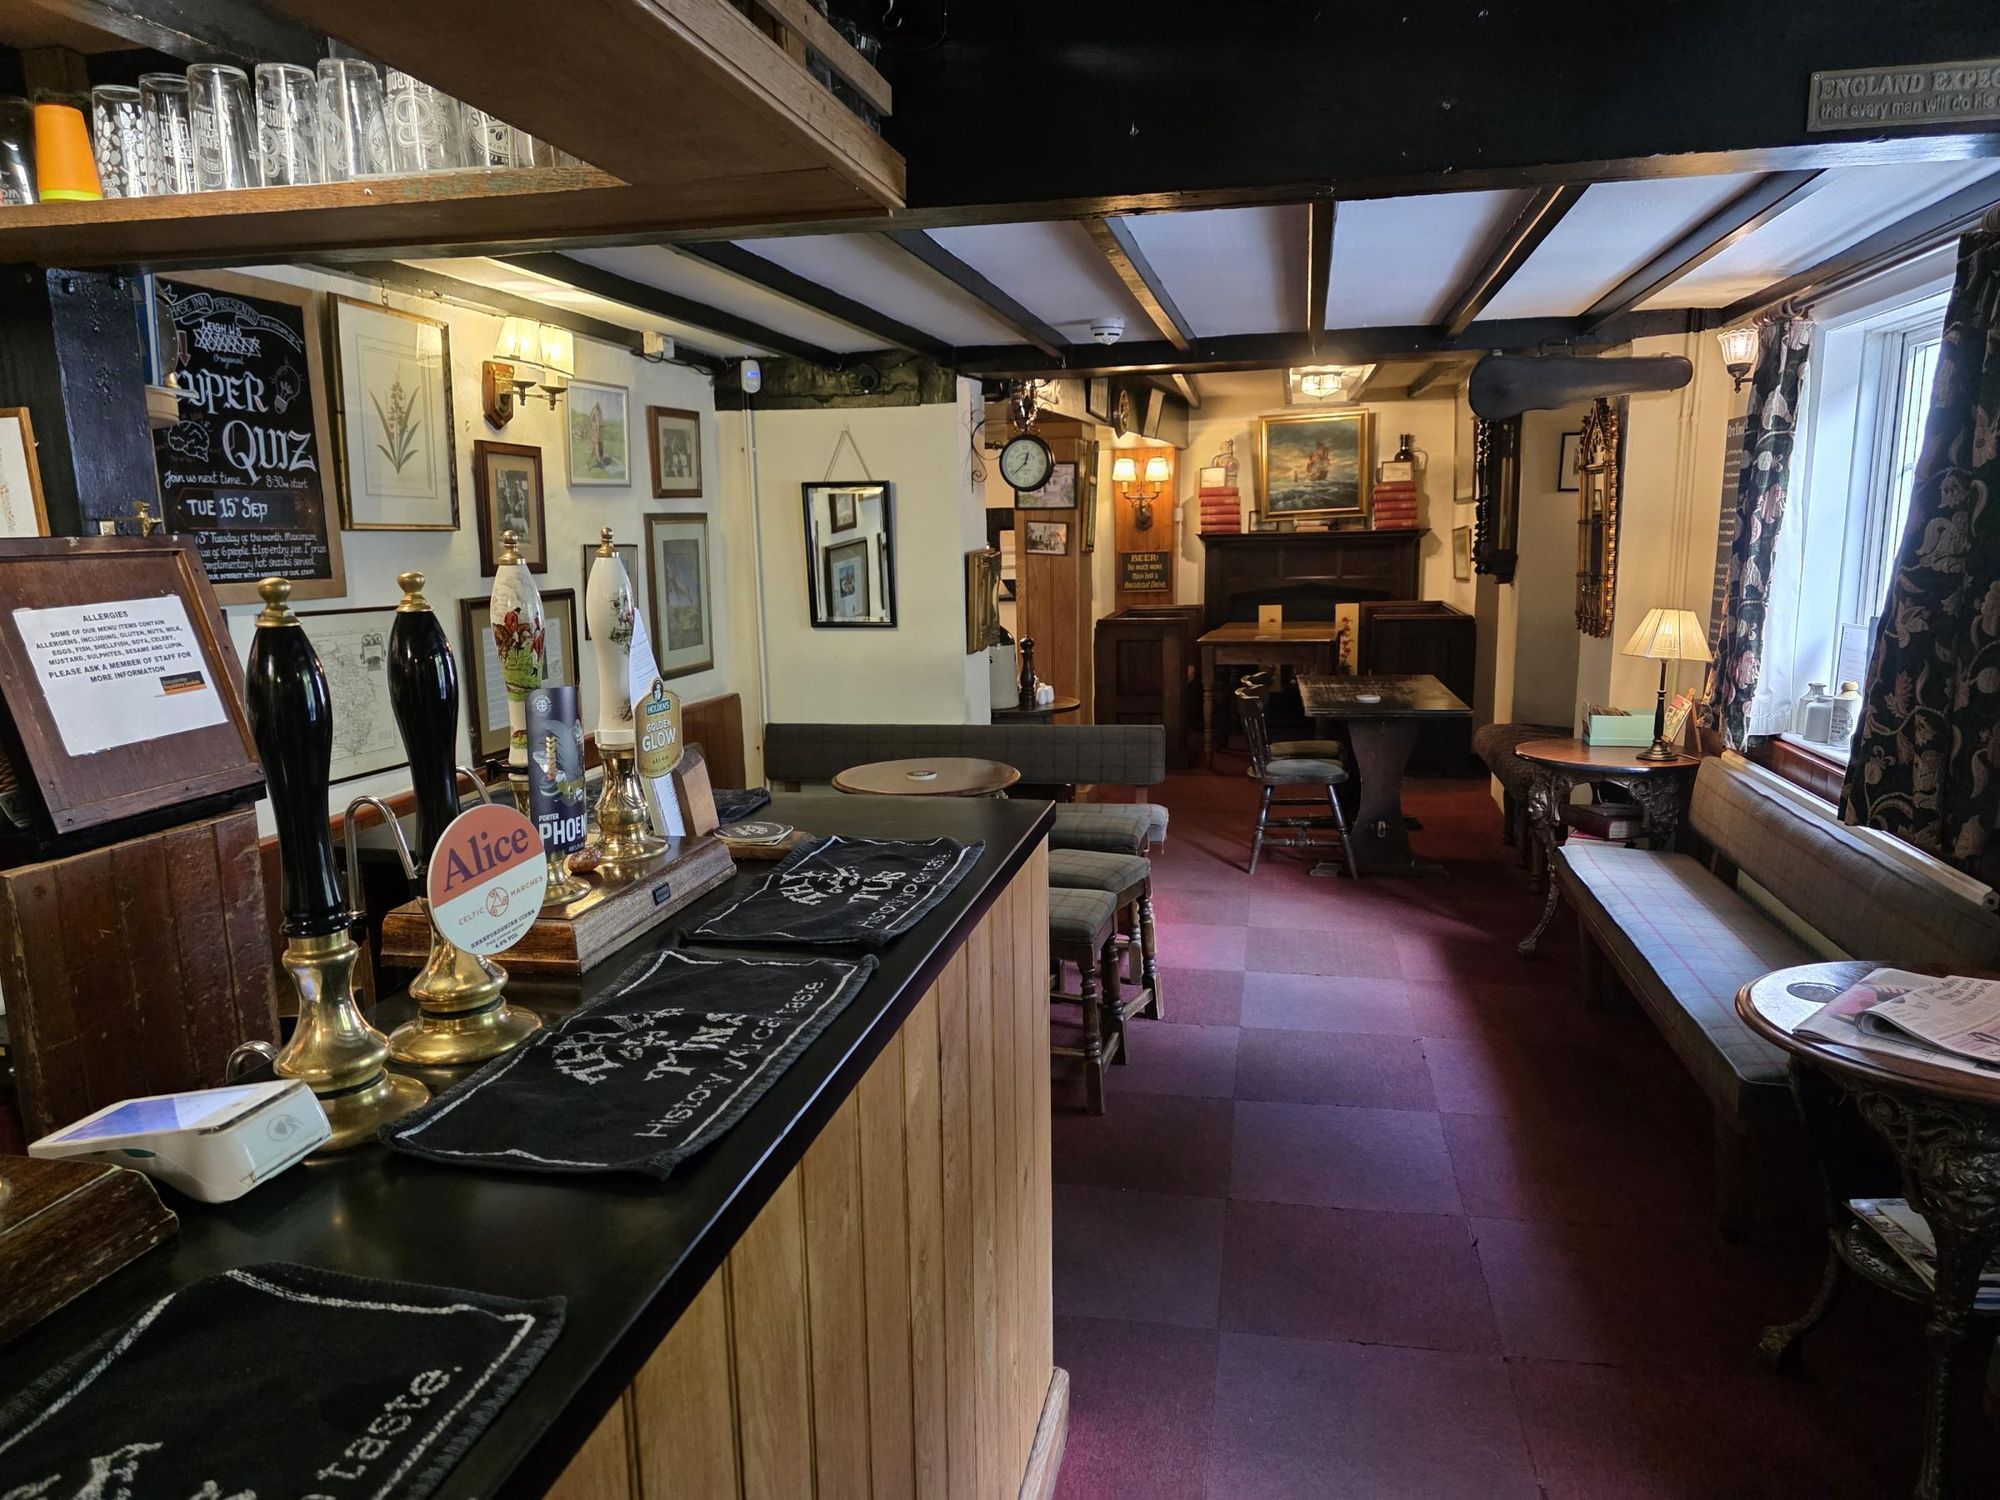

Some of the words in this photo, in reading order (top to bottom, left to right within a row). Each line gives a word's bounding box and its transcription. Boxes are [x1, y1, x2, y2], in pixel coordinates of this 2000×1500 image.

[1820, 74, 1924, 99] ENGLAND
[1821, 103, 1846, 119] that
[1850, 102, 1888, 120] every
[1891, 100, 1921, 114] man
[1925, 95, 1949, 113] will
[1951, 94, 1970, 110] do
[1974, 92, 1996, 109] his
[172, 302, 191, 317] HASE
[190, 295, 208, 310] INN
[214, 300, 257, 322] PRESENTS
[222, 420, 316, 486] QUIZ
[164, 470, 184, 488] Join
[187, 474, 196, 482] us
[198, 472, 218, 484] next
[290, 479, 308, 488] start
[186, 500, 216, 516] TUE
[210, 532, 239, 545] Tuesday
[250, 533, 262, 542] the
[82, 611, 129, 622] ALLERGIES
[125, 647, 150, 655] SESAME
[49, 668, 83, 679] PLEASE
[83, 665, 101, 674] ASK
[109, 659, 142, 670] MEMBER
[154, 654, 177, 663] STAFF
[177, 651, 192, 659] FOR
[90, 674, 113, 684] MORE
[114, 666, 166, 680] INFORMATION
[647, 719, 672, 732] GOLDEN
[642, 728, 676, 752] GLOW
[539, 813, 559, 822] PORTER
[443, 828, 529, 892] Alice
[458, 907, 485, 925] CELTIC
[510, 876, 544, 896] MARCHES
[633, 1072, 733, 1137] History
[316, 1366, 462, 1481] taste.
